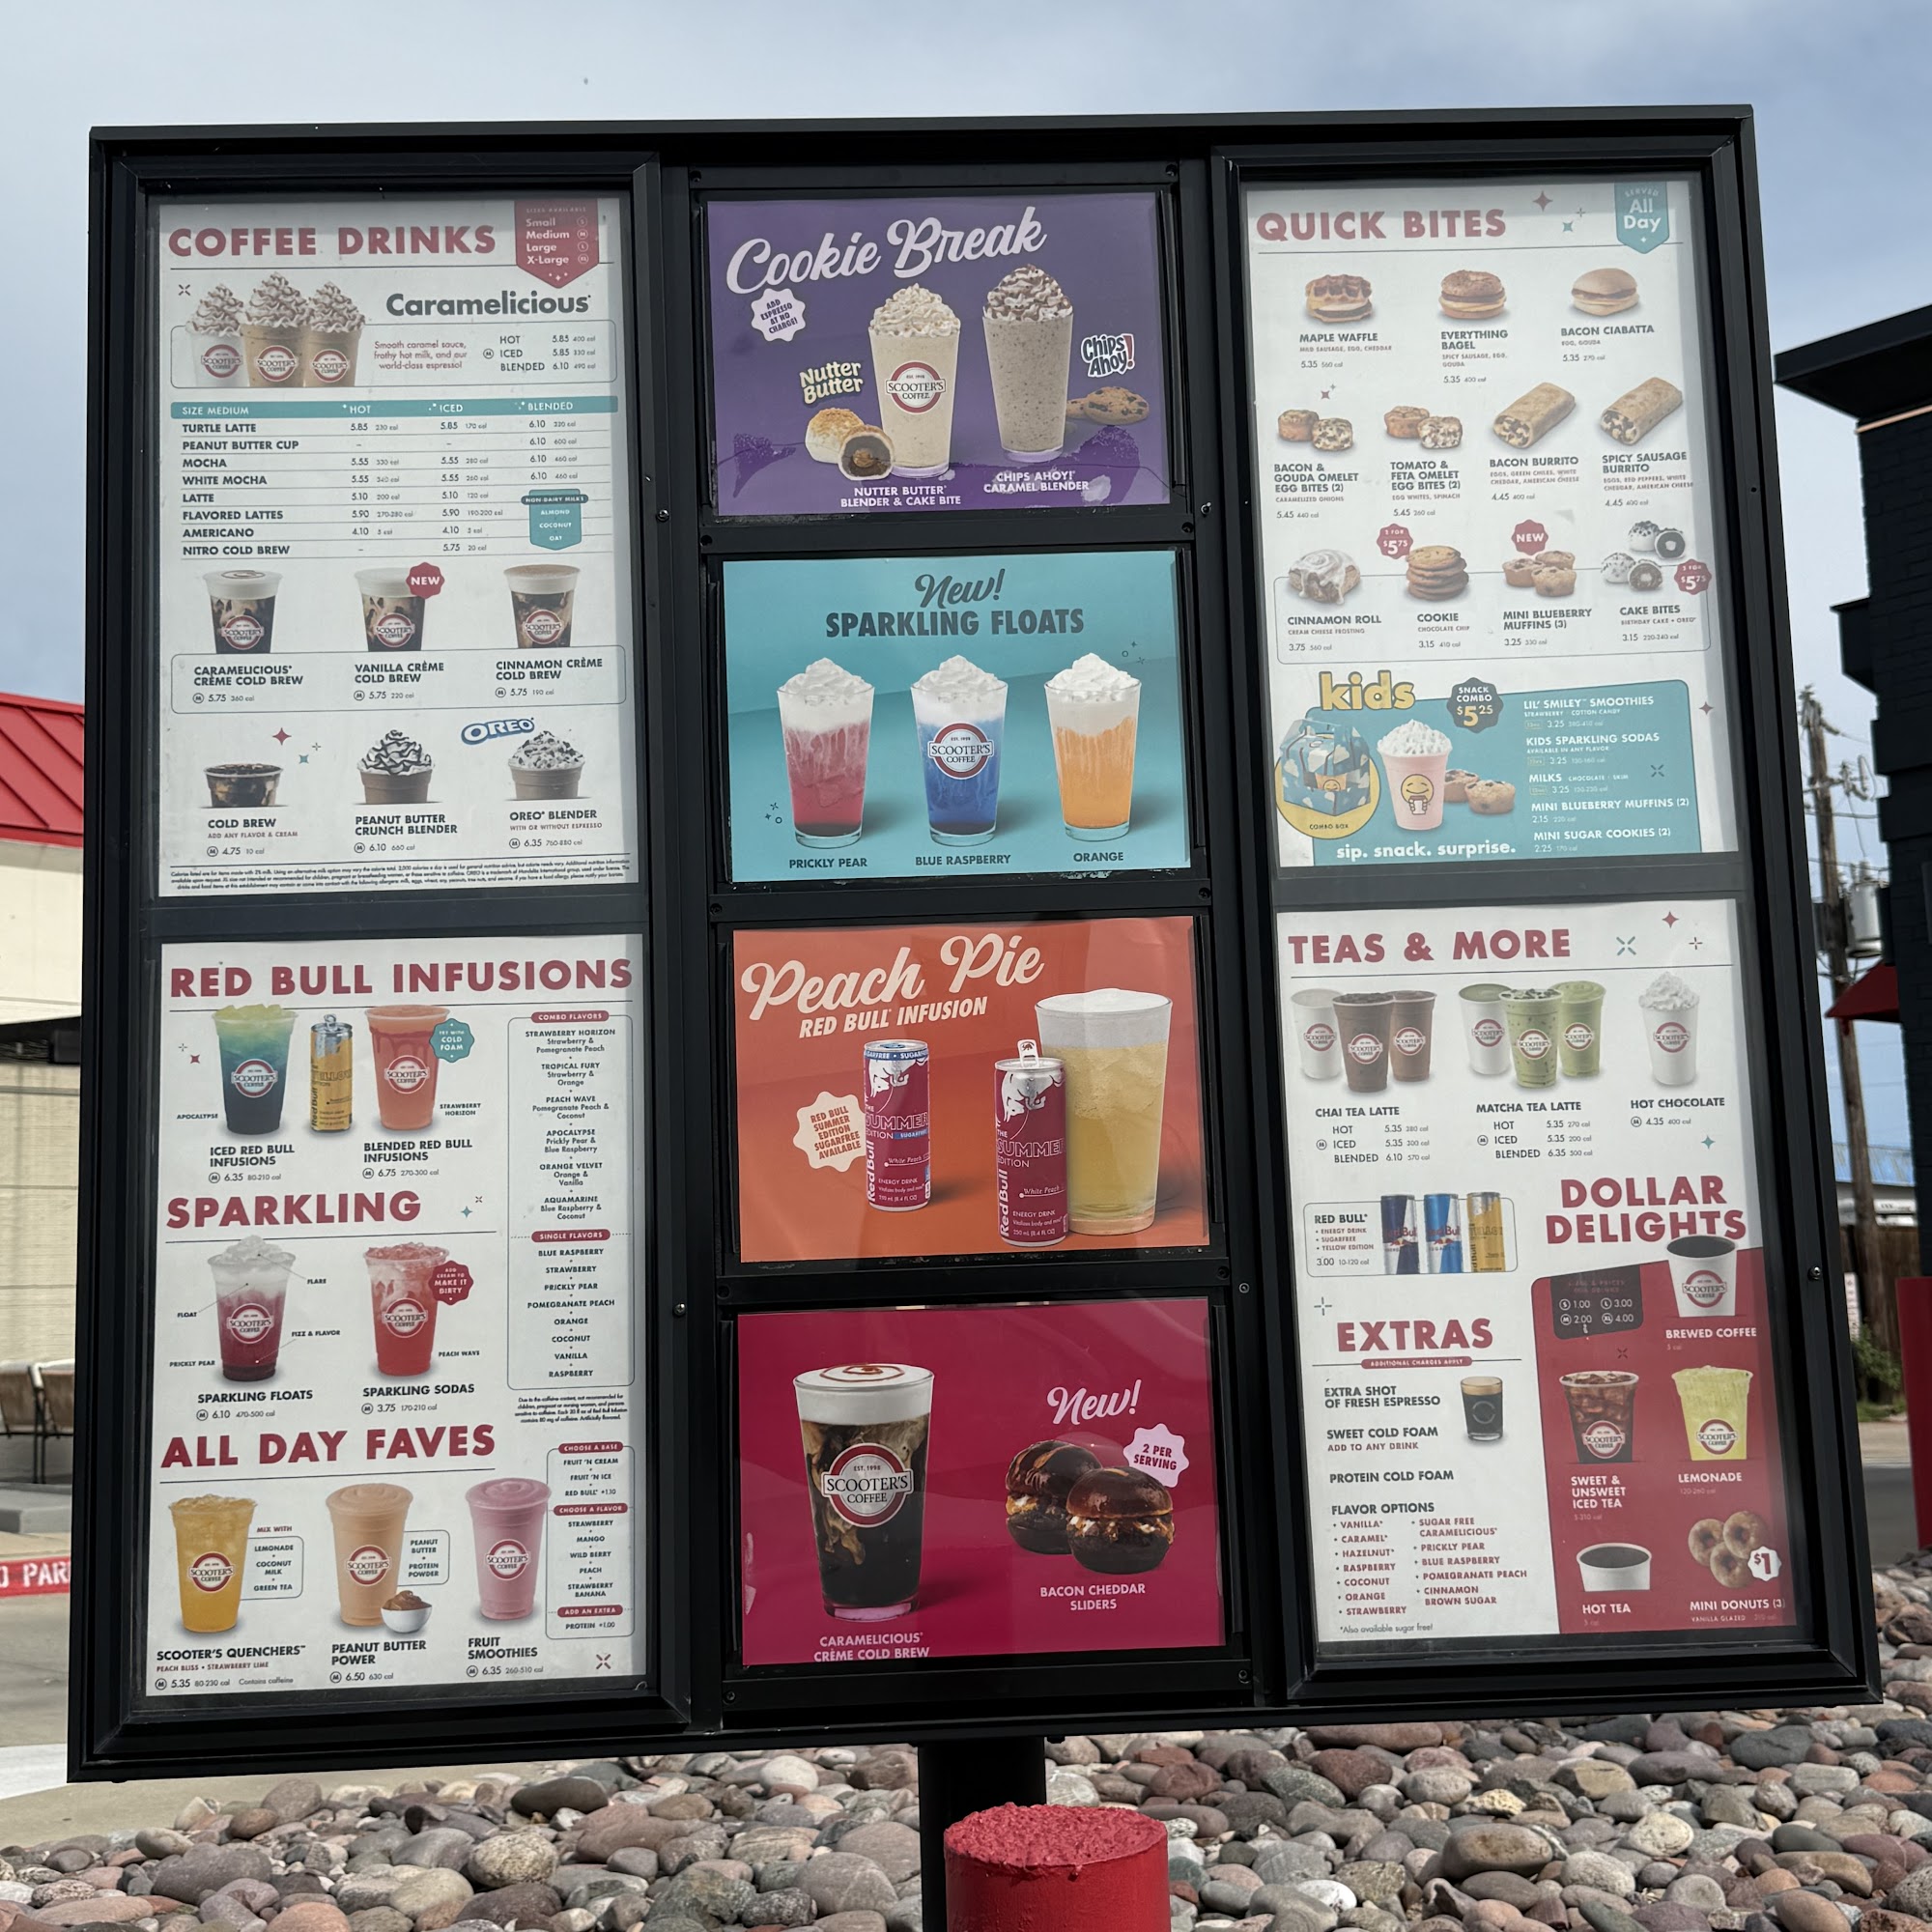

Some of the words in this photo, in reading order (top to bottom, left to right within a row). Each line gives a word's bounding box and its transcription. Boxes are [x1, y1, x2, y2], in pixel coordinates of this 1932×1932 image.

[1630, 197, 1654, 213] All
[526, 217, 555, 227] Small
[1256, 212, 1387, 242] QUICK
[1403, 209, 1506, 238] BITES
[1624, 215, 1661, 232] Day
[169, 227, 316, 257] COFFEE
[336, 224, 495, 255] DRINKS
[526, 230, 569, 239] Medium
[526, 243, 556, 253] Large
[726, 232, 881, 294] Cookie
[887, 207, 1047, 278] Break
[527, 256, 569, 266] X-Large
[1441, 330, 1508, 339] EVERYTHING
[1561, 327, 1599, 336] BACON
[1604, 326, 1654, 334] CIABATTA
[500, 335, 521, 344] HOT
[1300, 333, 1334, 342] MAPLE
[1442, 341, 1475, 350] BAGEL
[800, 362, 861, 387] Nutter
[804, 378, 863, 404] Butter
[183, 424, 220, 433] TURTLE
[231, 440, 272, 451] BUTTER
[183, 459, 227, 468] MOCHA
[1490, 459, 1528, 468] BACON
[1533, 457, 1578, 466] BURRITO
[183, 476, 218, 485] WHITE
[222, 474, 268, 485] MOCHA
[983, 483, 1037, 494] CARAMEL
[1040, 481, 1089, 492] BLENDER
[183, 494, 213, 502] LATTE
[840, 497, 891, 508] BLENDER
[906, 497, 935, 505] CAKE
[939, 496, 961, 504] BITE
[183, 510, 241, 522] FLAVORED
[244, 509, 284, 520] LATTES
[184, 525, 255, 540] AMERICANO
[1517, 533, 1544, 542] NEW
[223, 546, 252, 554] COLD
[915, 568, 1005, 609] New!
[1620, 607, 1648, 615] CAKE
[1653, 605, 1680, 614] BITES
[826, 611, 979, 638] SPARKLING
[991, 609, 1084, 635] FLOATS
[1288, 616, 1350, 625] CINNAMON
[1417, 613, 1459, 622] COOKIE
[1319, 670, 1415, 711] kids
[930, 743, 991, 755] SCOOTER'S
[208, 819, 239, 828] COLD
[243, 818, 276, 828] BREW
[355, 815, 401, 825] PEANUT
[405, 814, 445, 823] BUTTER
[355, 826, 403, 836] CRUNCH
[408, 825, 457, 834] BLENDER
[1337, 844, 1368, 862] sip.
[1375, 841, 1432, 857] snack.
[1438, 839, 1516, 858] surprise.
[789, 859, 835, 868] PRICKLY
[838, 858, 867, 867] PEAR
[916, 857, 942, 866] BLUE
[947, 855, 1010, 865] RASPBERRY
[1073, 852, 1123, 862] ORANGE
[1288, 933, 1384, 964] TEAS
[1404, 932, 1434, 961] &
[1453, 929, 1570, 959] MORE
[171, 967, 251, 997] RED
[272, 965, 372, 995] BULL
[393, 959, 633, 992] INFUSIONS
[741, 947, 925, 1020] Peach
[941, 933, 1044, 993] Pie
[799, 1020, 836, 1038] RED
[896, 997, 987, 1025] INFUSION
[1476, 1103, 1523, 1113] MATCHA
[1550, 1102, 1581, 1111] LATTE
[1658, 1097, 1724, 1107] CHOCOLATE
[1316, 1108, 1342, 1117] CHAI
[1370, 1107, 1399, 1116] LATTE
[813, 1116, 851, 1131] SUMMER
[817, 1124, 851, 1139] EDITION
[813, 1131, 860, 1150] SUGARFREE
[818, 1141, 860, 1159] AVAILABLE
[1561, 1176, 1727, 1208] DOLLAR
[166, 1191, 420, 1229] SPARKLING
[1547, 1209, 1746, 1244] DELIGHTS
[1337, 1319, 1492, 1351] EXTRAS
[1666, 1329, 1713, 1339] BREWED
[1717, 1328, 1756, 1337] COFFEE
[363, 1385, 430, 1397] SPARKLING
[435, 1384, 474, 1394] SODAS
[1324, 1387, 1361, 1397] EXTRA
[1366, 1386, 1396, 1396] SHOT
[198, 1392, 266, 1404] SPARKLING
[270, 1390, 313, 1401] FLOATS
[1047, 1379, 1141, 1425] New!
[1325, 1399, 1340, 1408] OF
[1345, 1398, 1379, 1407] FRESH
[1384, 1396, 1440, 1406] ESPRESSO
[1327, 1429, 1364, 1439] SWEET
[1368, 1428, 1399, 1437] COLD
[1403, 1427, 1438, 1436] FOAM
[160, 1435, 238, 1468] ALL
[260, 1431, 347, 1463] DAY
[367, 1424, 495, 1460] FAVES
[1143, 1444, 1150, 1453] 2
[1152, 1445, 1172, 1458] PER
[1134, 1454, 1177, 1470] SERVING
[827, 1474, 908, 1492] SCOOTER'S
[1679, 1472, 1742, 1483] LEMONADE
[847, 1492, 888, 1505] COFFEE
[1344, 1563, 1395, 1572] RASPBERRY
[23, 1562, 71, 1587] PAR
[1040, 1586, 1084, 1597] BACON
[1089, 1583, 1145, 1595] CHEDDAR
[1070, 1599, 1117, 1610] SLIDERS
[1582, 1605, 1605, 1614] HOT
[1610, 1604, 1631, 1613] TEA
[1690, 1601, 1717, 1610] MINI
[1721, 1600, 1769, 1609] DONUTS
[332, 1642, 380, 1653] PEANUT
[384, 1640, 426, 1651] BUTTER
[469, 1637, 500, 1647] FRUIT
[469, 1647, 537, 1660] SMOOTHIES
[332, 1655, 375, 1665] POWER
